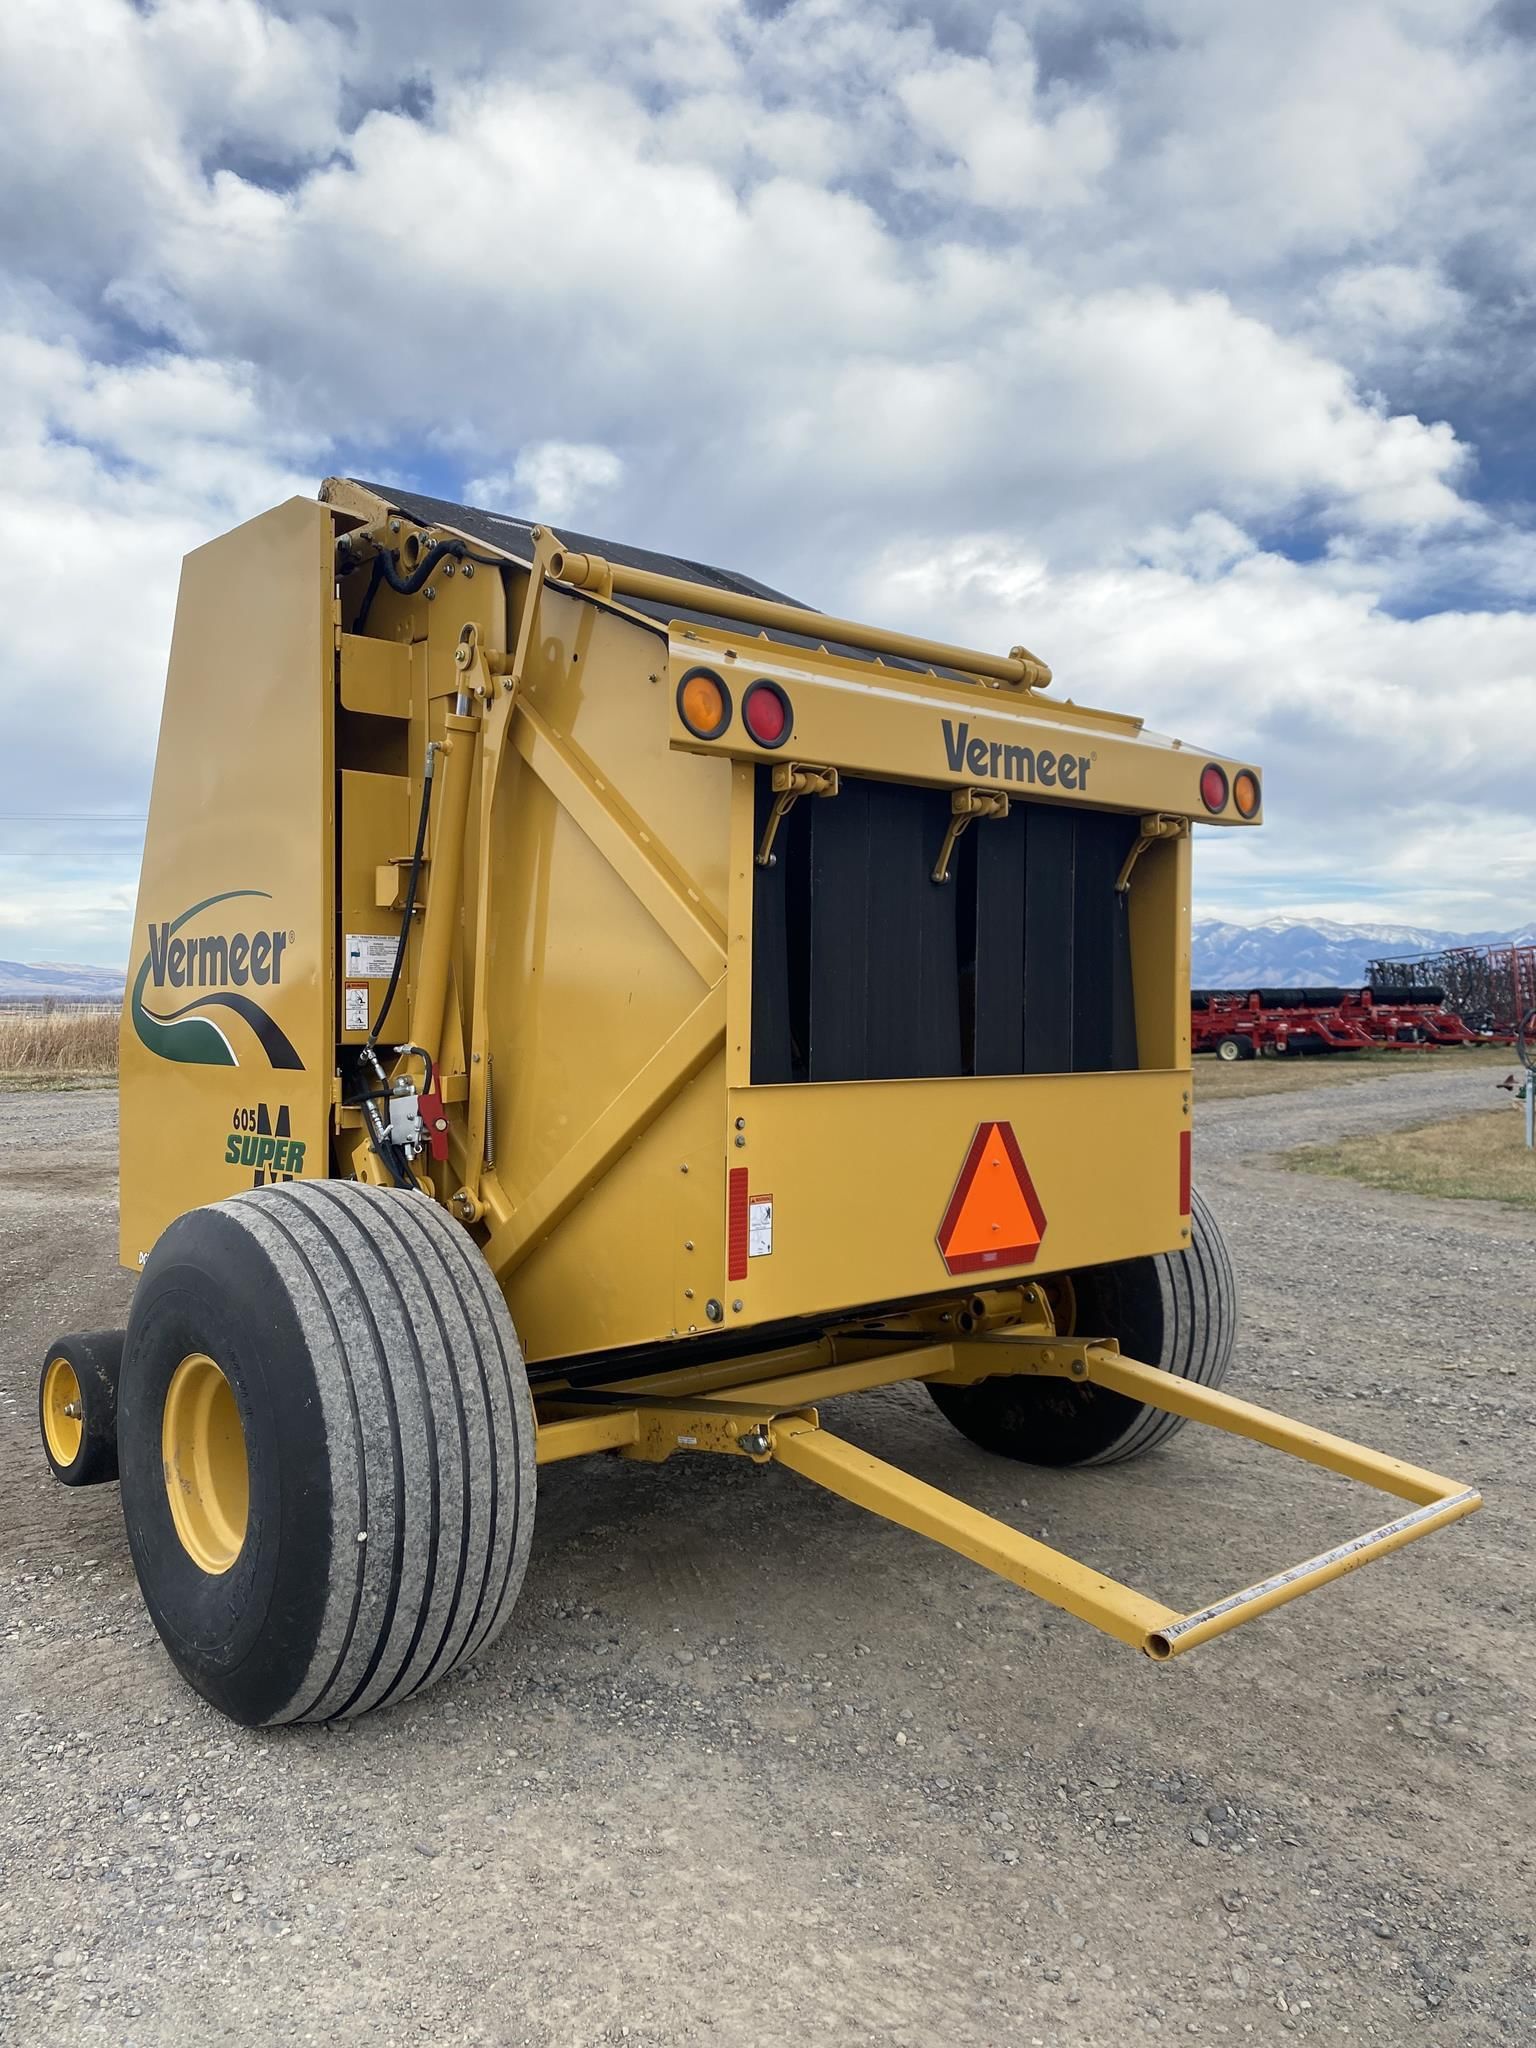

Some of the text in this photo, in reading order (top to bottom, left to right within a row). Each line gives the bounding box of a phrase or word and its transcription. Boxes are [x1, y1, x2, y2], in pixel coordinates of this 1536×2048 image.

[940, 718, 1091, 791] Vermeer
[148, 922, 287, 988] Vermeer
[233, 1107, 256, 1132] 605
[224, 1133, 306, 1174] SUPER
